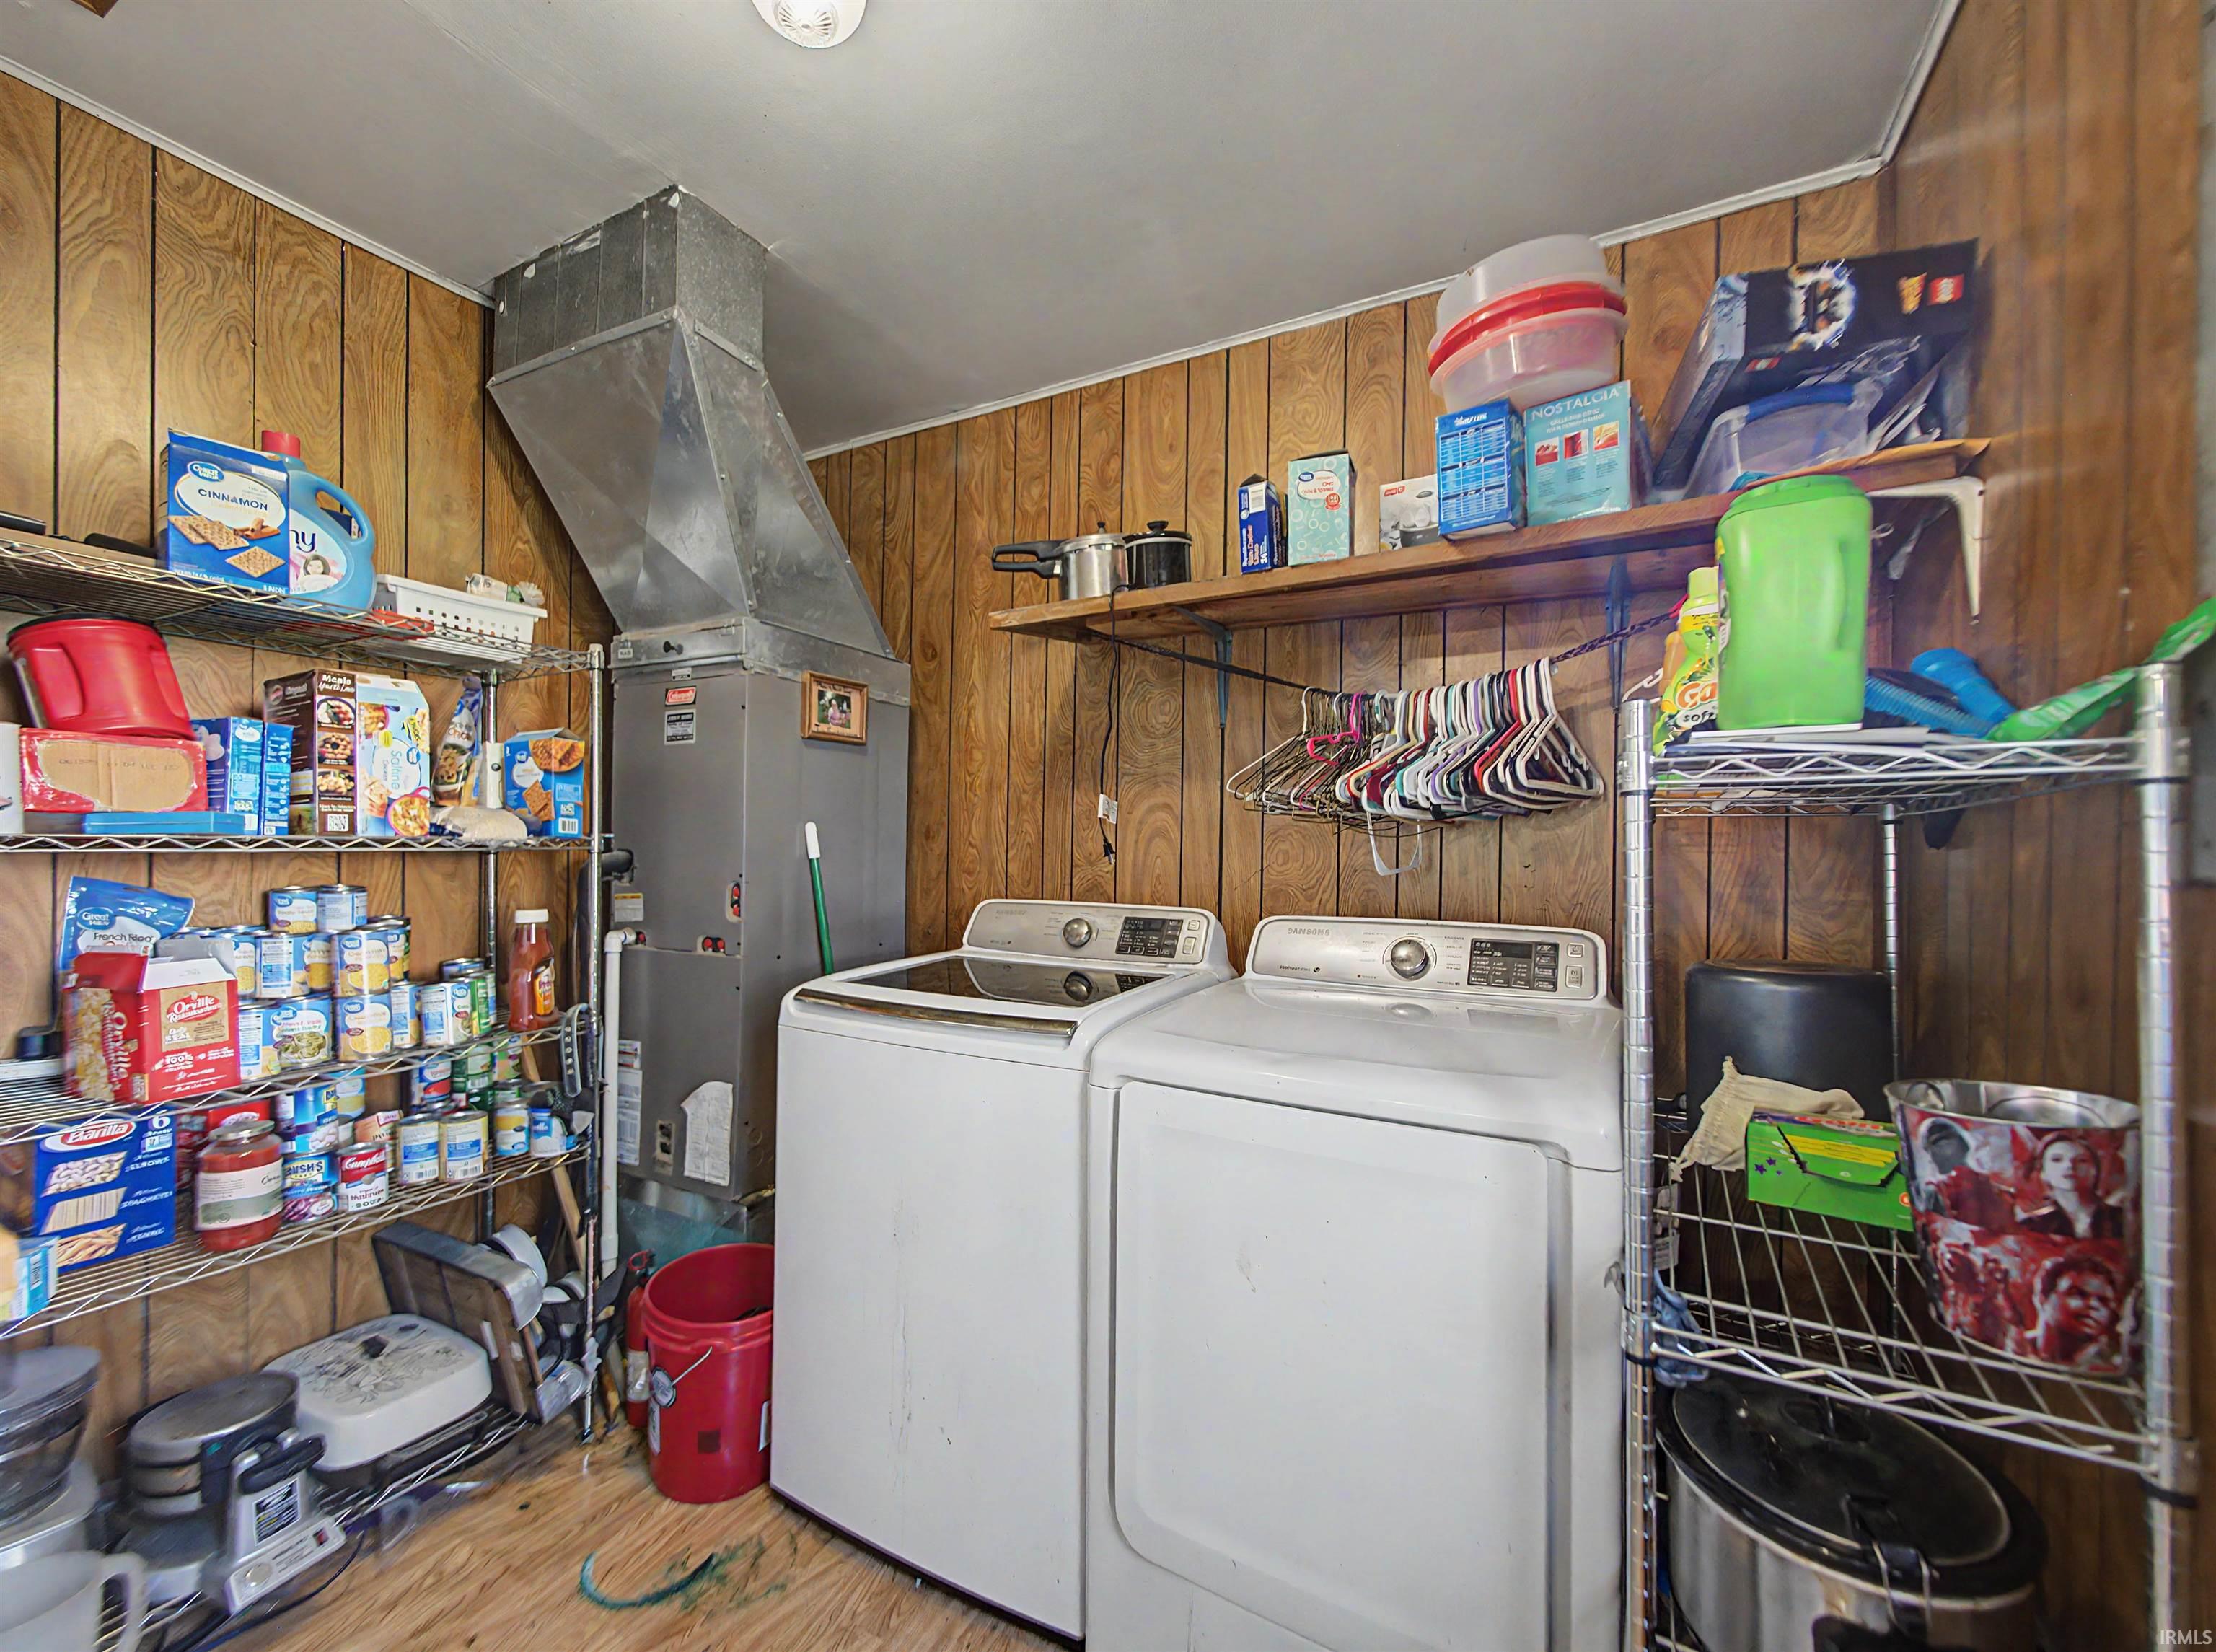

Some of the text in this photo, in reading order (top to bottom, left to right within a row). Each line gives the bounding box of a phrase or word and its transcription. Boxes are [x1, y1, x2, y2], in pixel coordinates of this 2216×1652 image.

[1531, 388, 1619, 421] NOSTALGIA
[198, 488, 268, 511] CINNAMON
[391, 750, 403, 790] Saltine
[93, 931, 128, 942] French
[172, 995, 216, 1014] Orville
[66, 1122, 129, 1144] Barilla
[152, 1115, 171, 1130] 6
